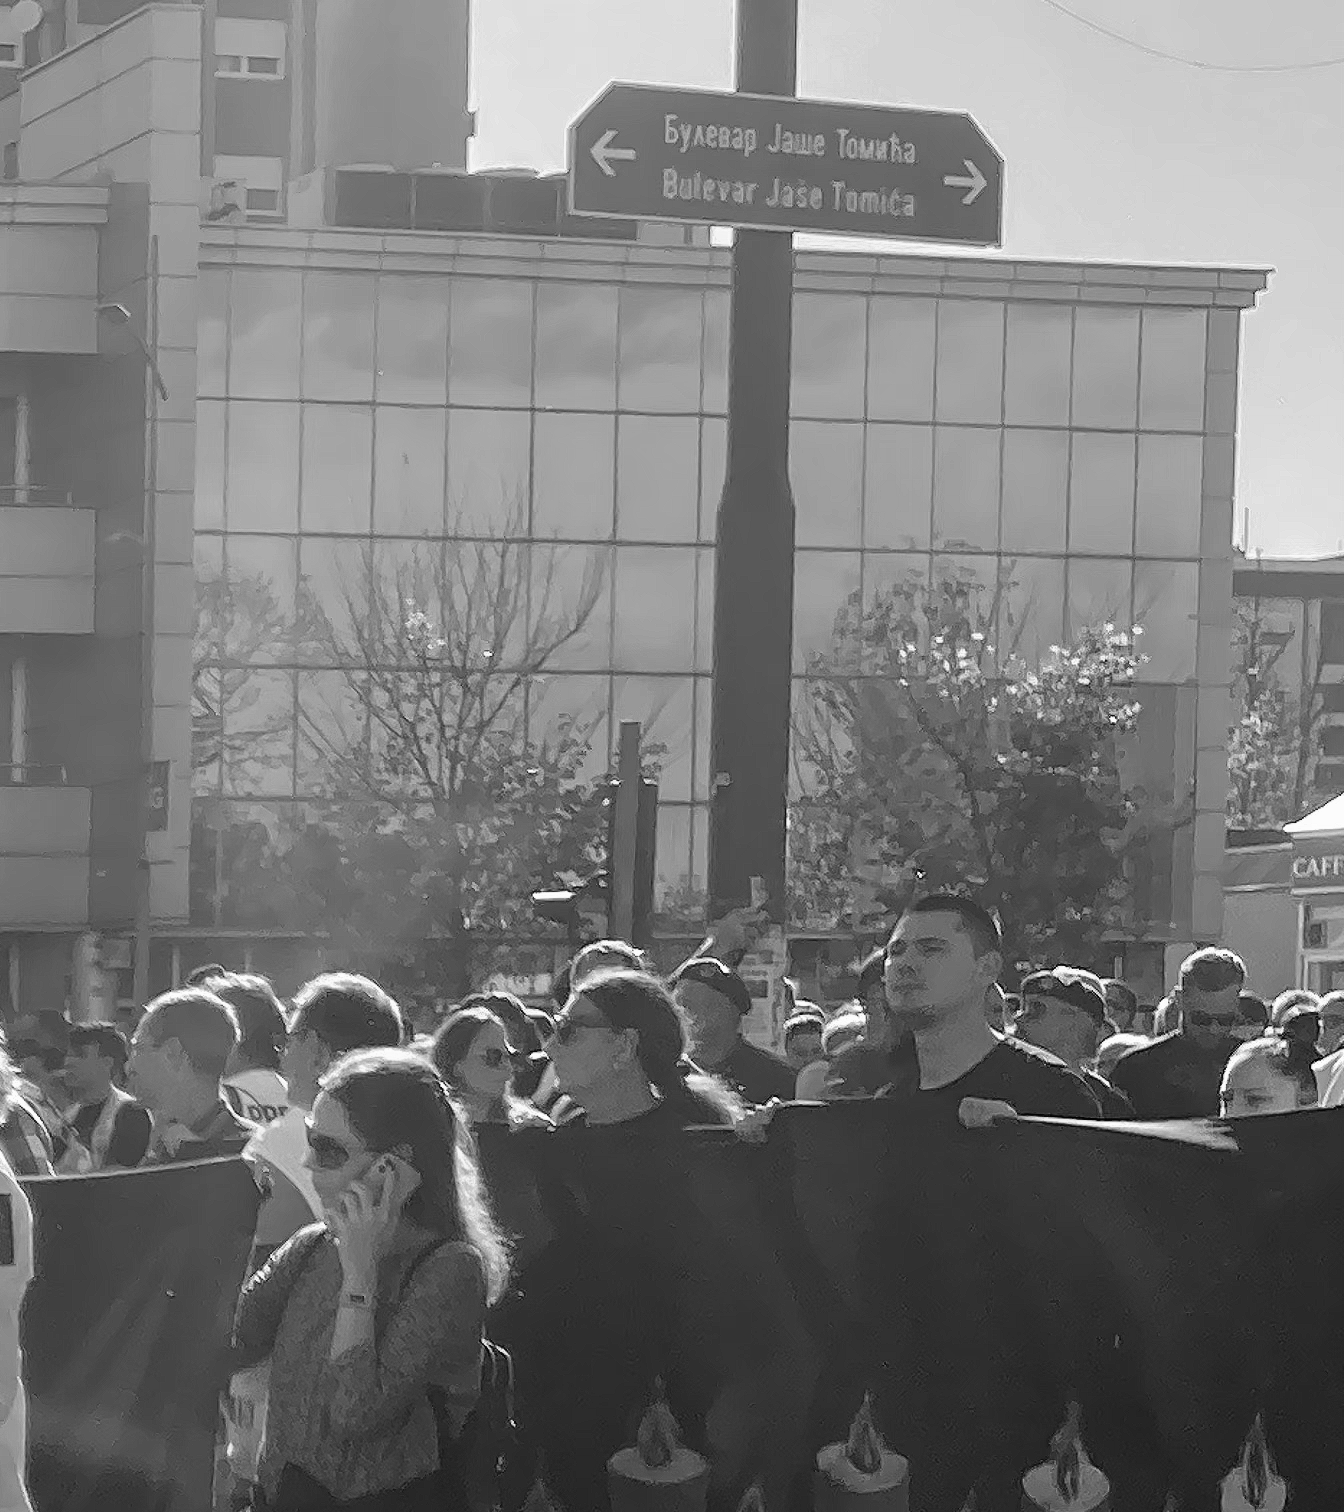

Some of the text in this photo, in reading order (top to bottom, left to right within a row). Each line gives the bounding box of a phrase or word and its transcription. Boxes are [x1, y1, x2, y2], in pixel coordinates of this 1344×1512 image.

[664, 114, 917, 164] Булевар Јаше Томића
[663, 167, 760, 206] Bulevar
